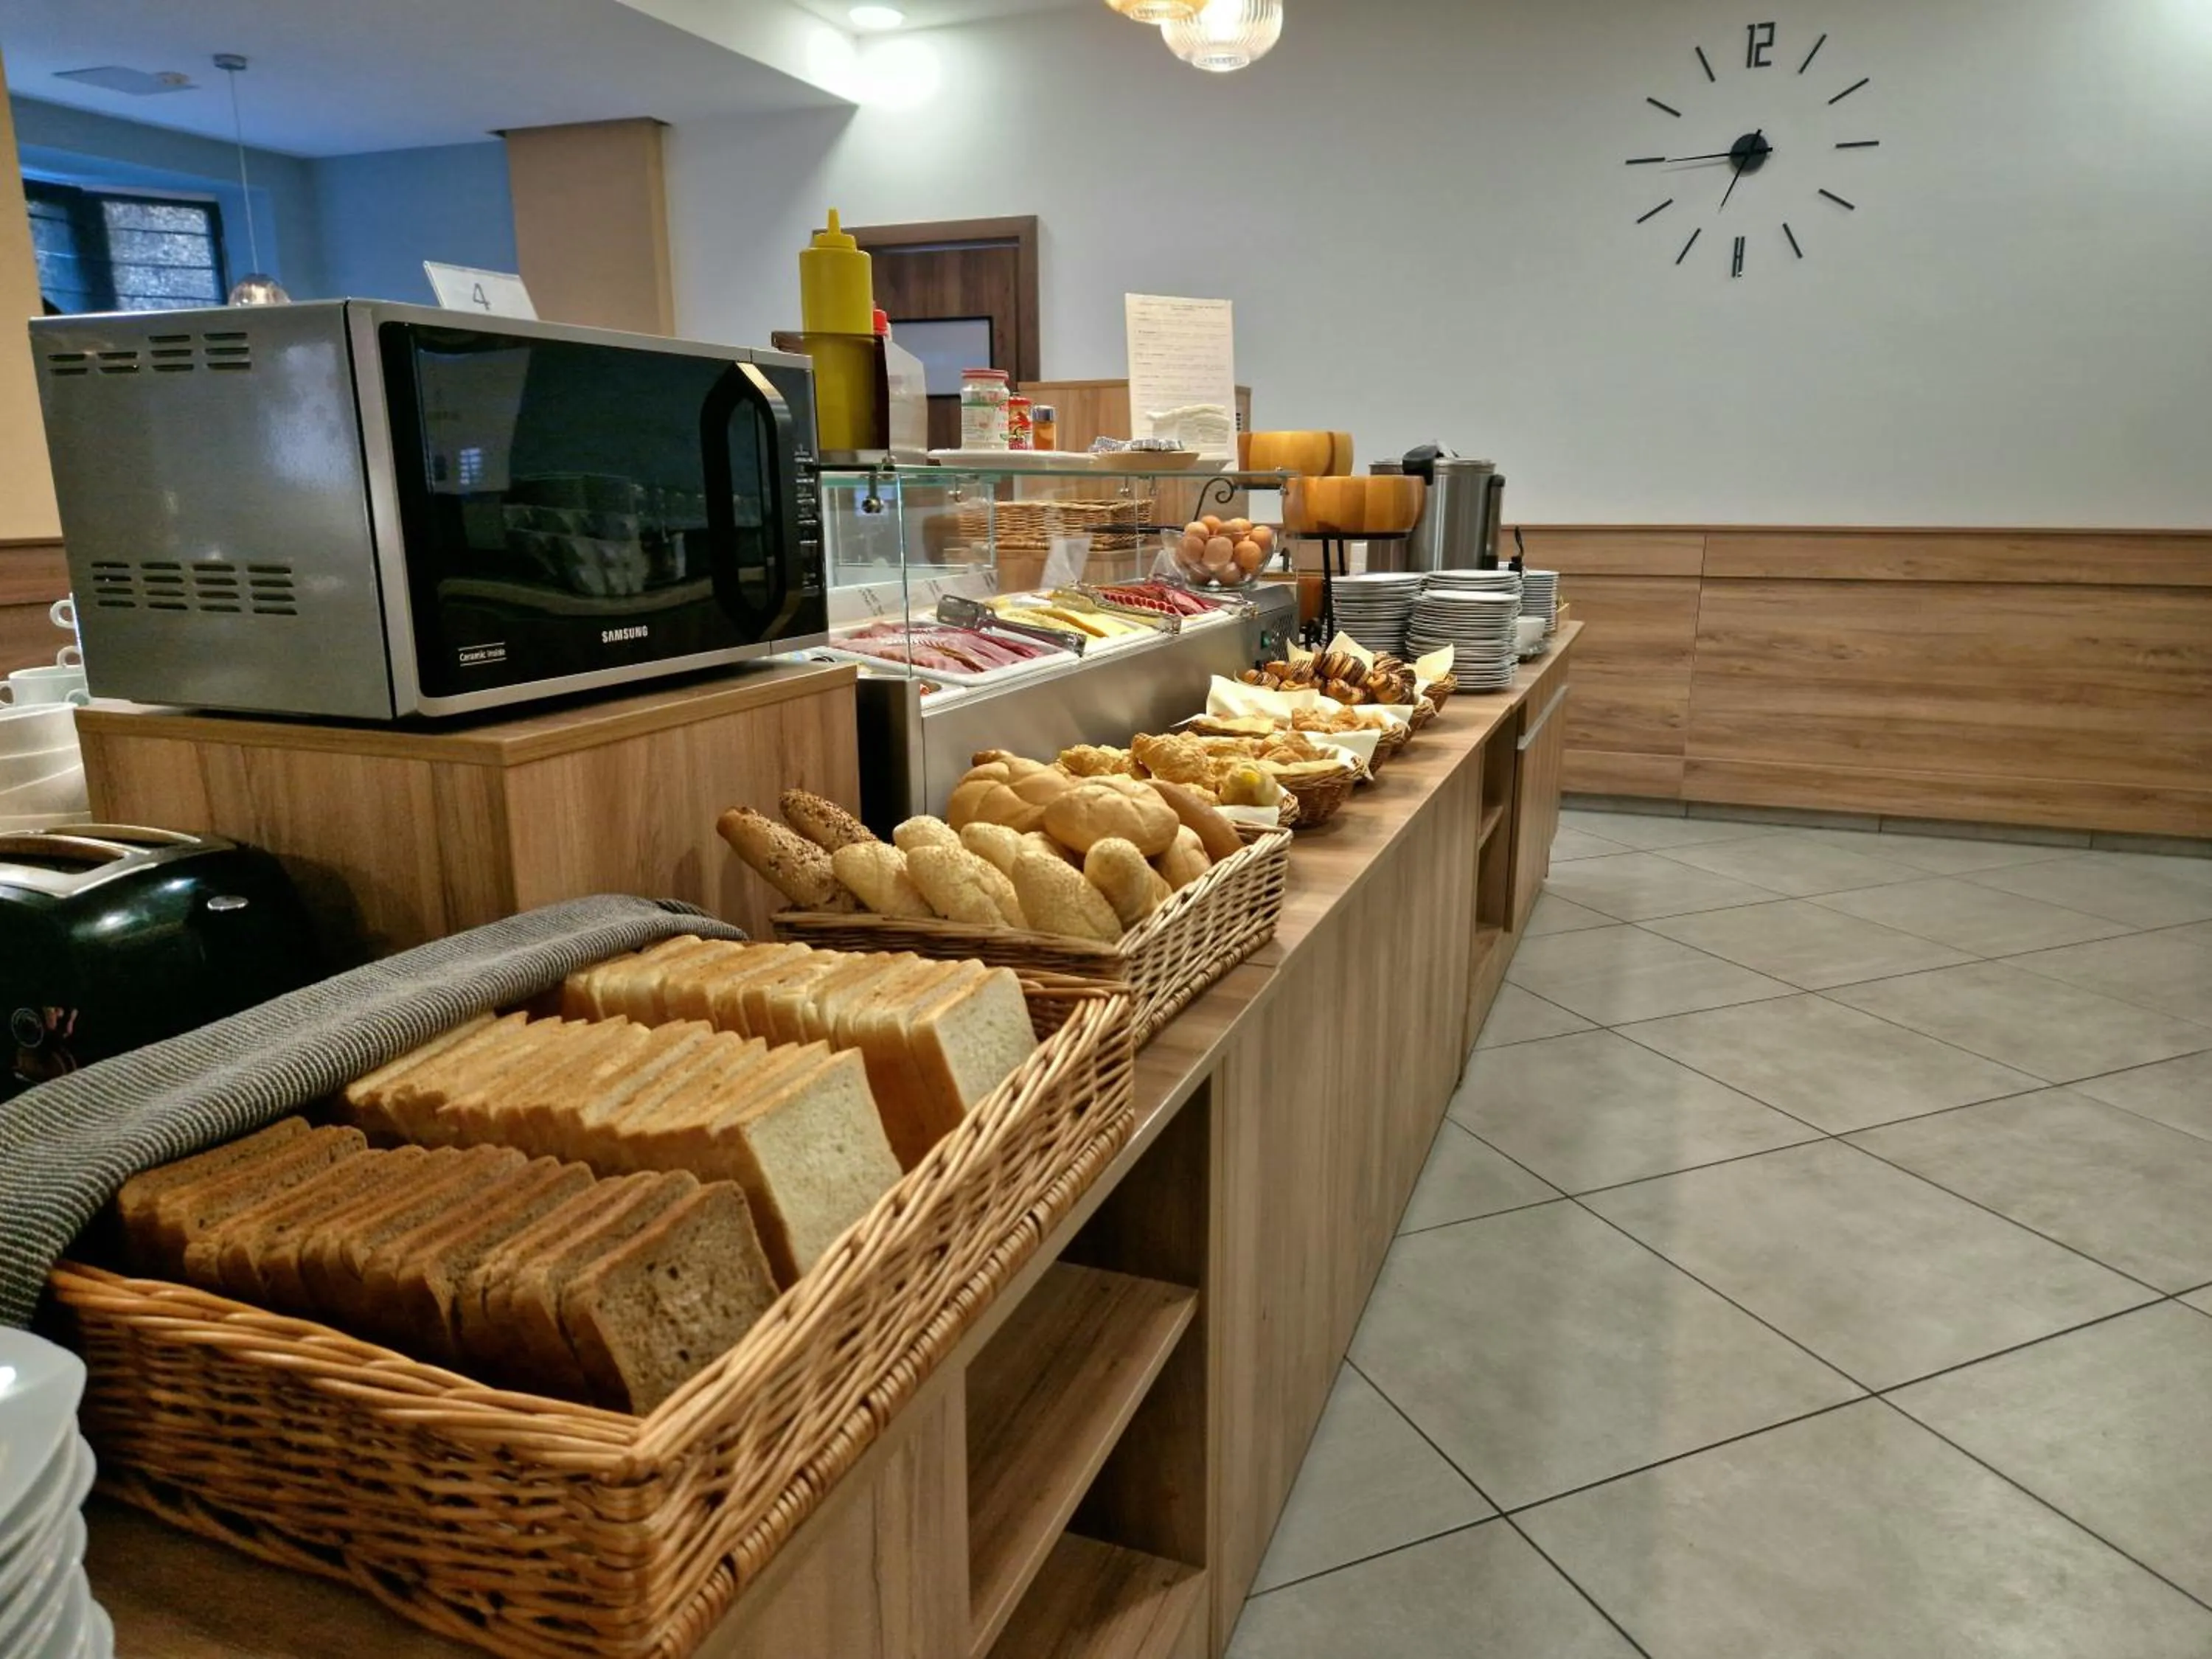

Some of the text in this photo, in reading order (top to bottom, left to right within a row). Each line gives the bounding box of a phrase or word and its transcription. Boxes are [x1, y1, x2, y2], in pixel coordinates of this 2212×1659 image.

[1746, 22, 1775, 69] 12
[473, 283, 491, 310] 4
[602, 625, 648, 643] SAMSUNG
